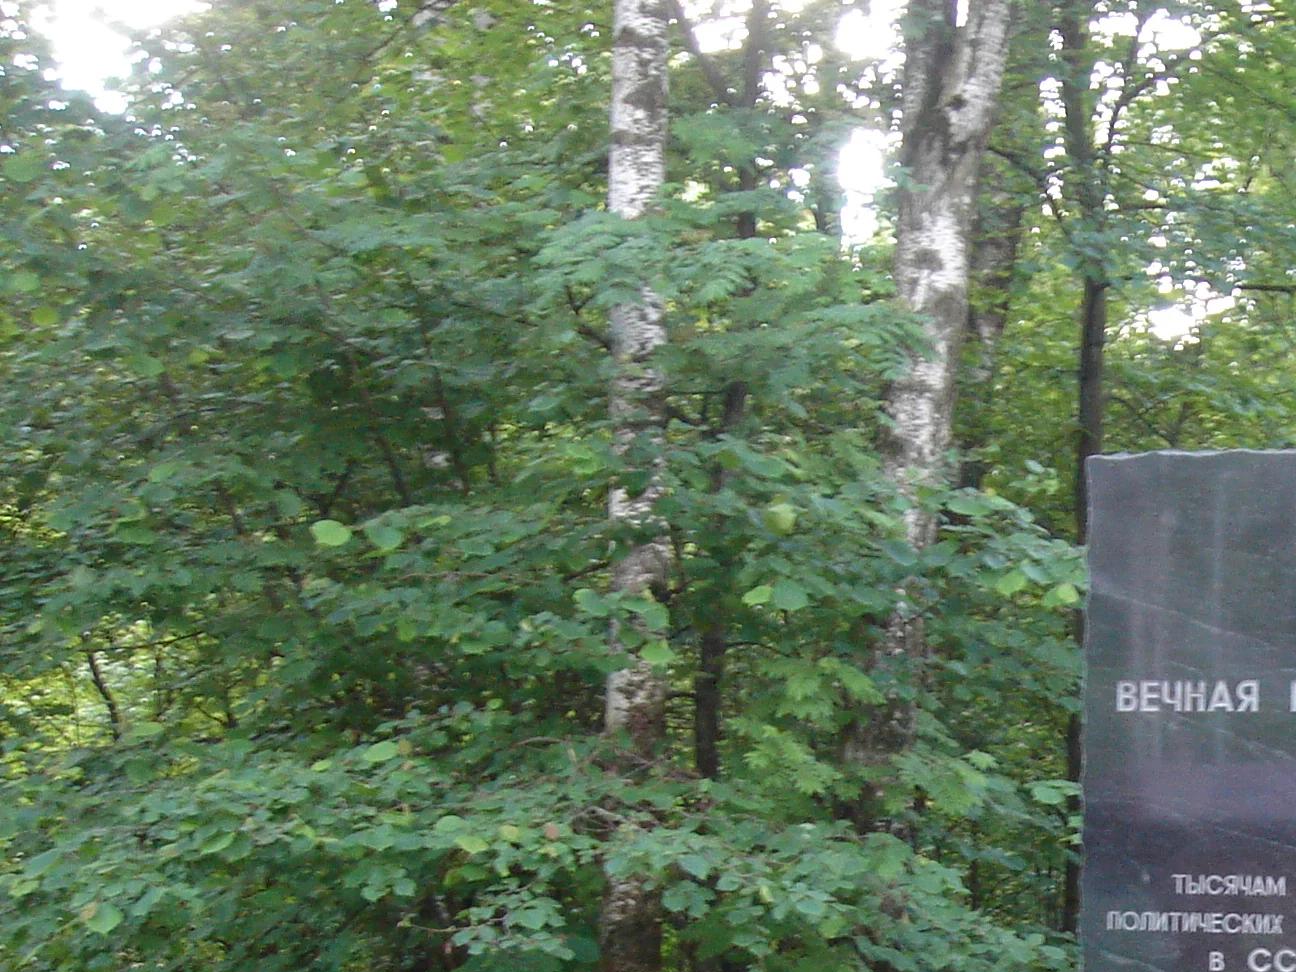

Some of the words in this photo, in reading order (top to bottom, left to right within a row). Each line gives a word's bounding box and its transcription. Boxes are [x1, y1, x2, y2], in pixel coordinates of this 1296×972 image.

[1115, 679, 1260, 712] ВЕЧНАЯ
[1171, 873, 1287, 896] ТЫСЯЧАМ
[1106, 911, 1284, 934] ПОЛИТИЧЕСКИХ
[1209, 952, 1225, 972] В
